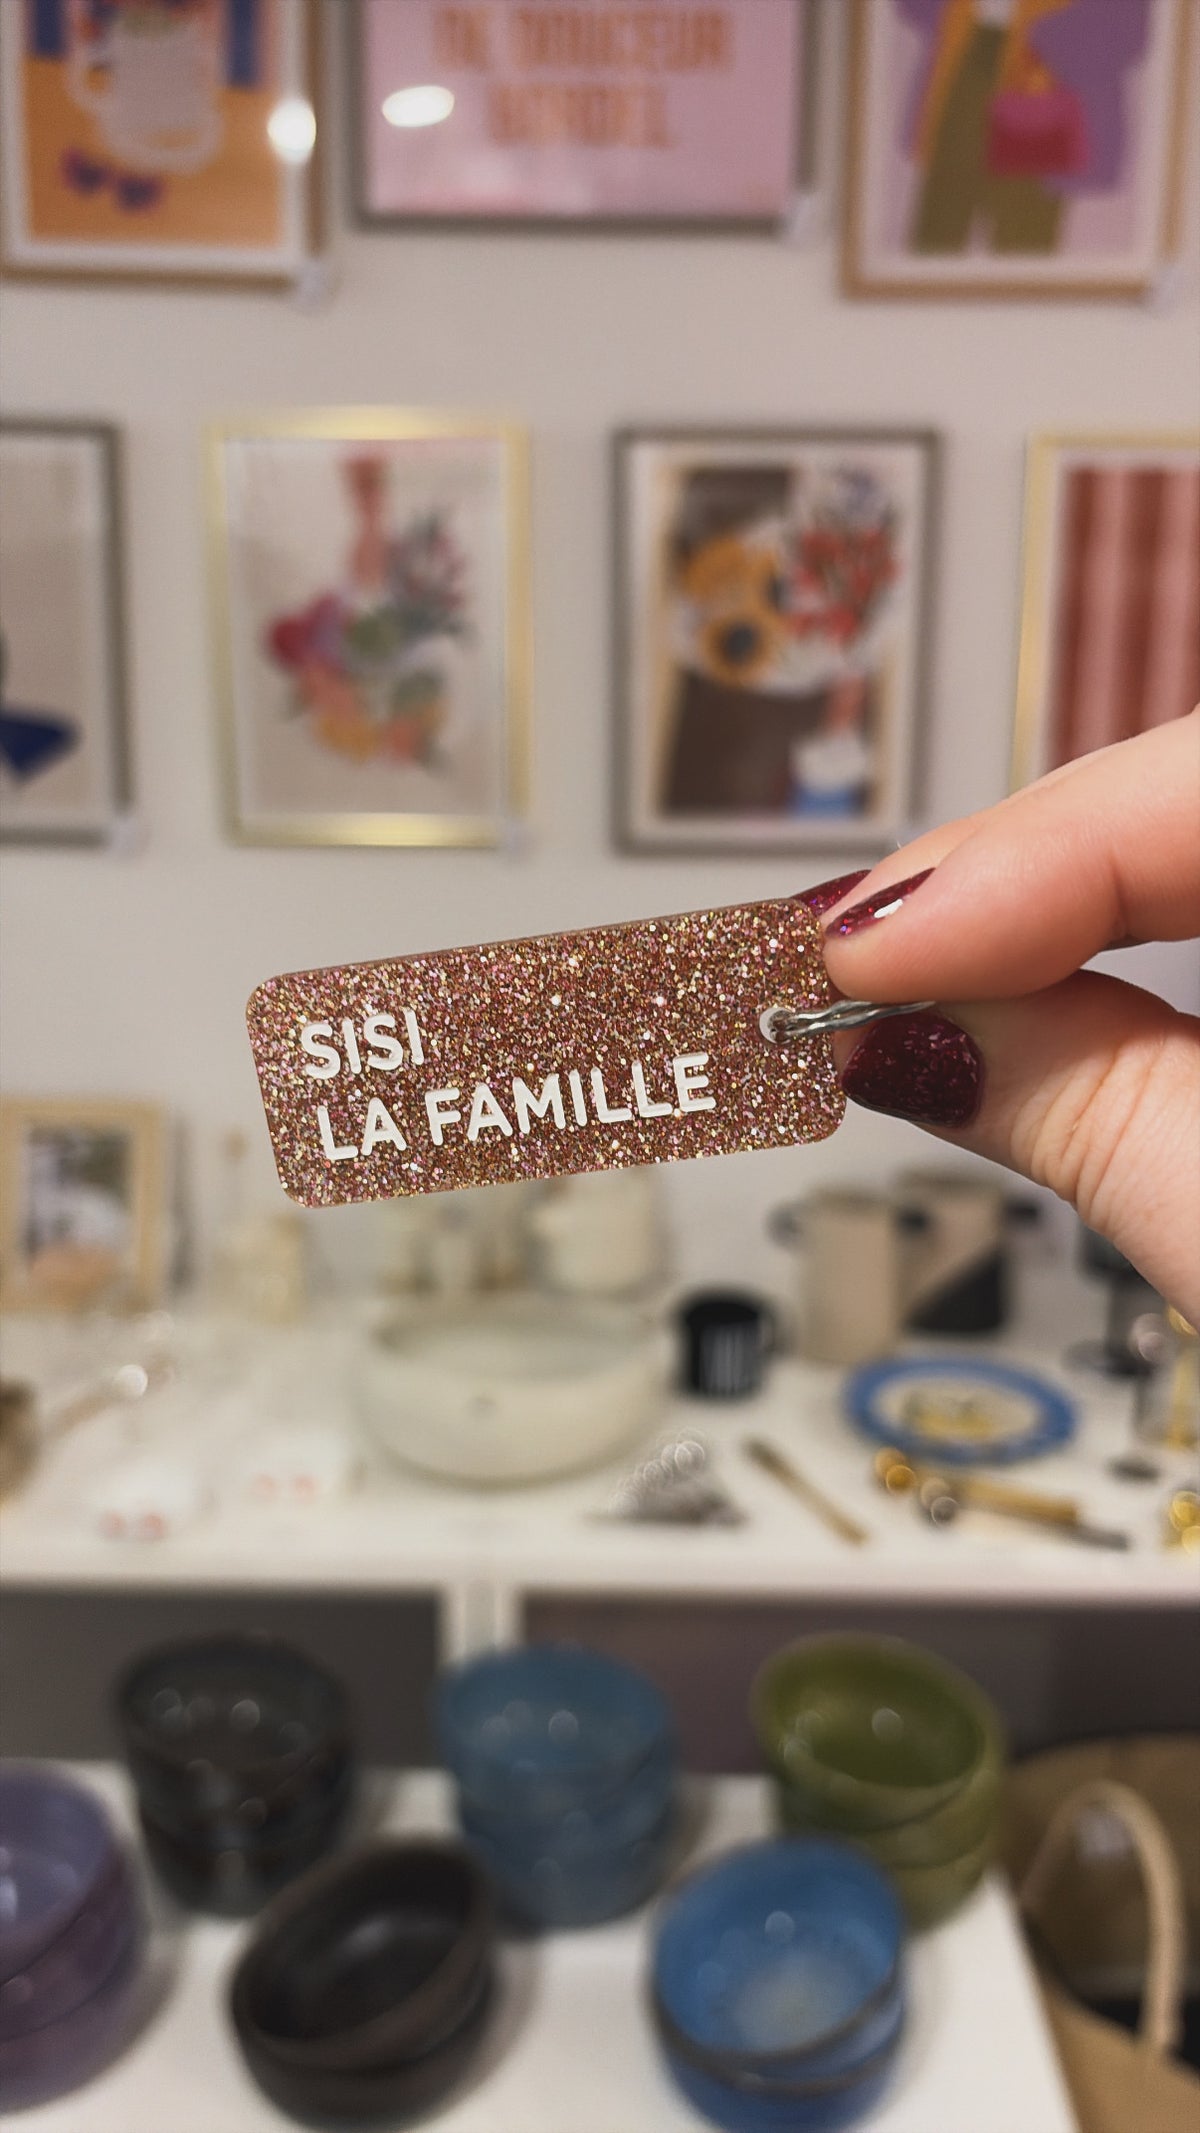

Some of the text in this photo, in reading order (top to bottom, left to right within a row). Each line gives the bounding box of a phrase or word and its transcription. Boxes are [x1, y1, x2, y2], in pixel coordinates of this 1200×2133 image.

[300, 1009, 424, 1079] SISI
[317, 1053, 717, 1161] LA FAMILLE
